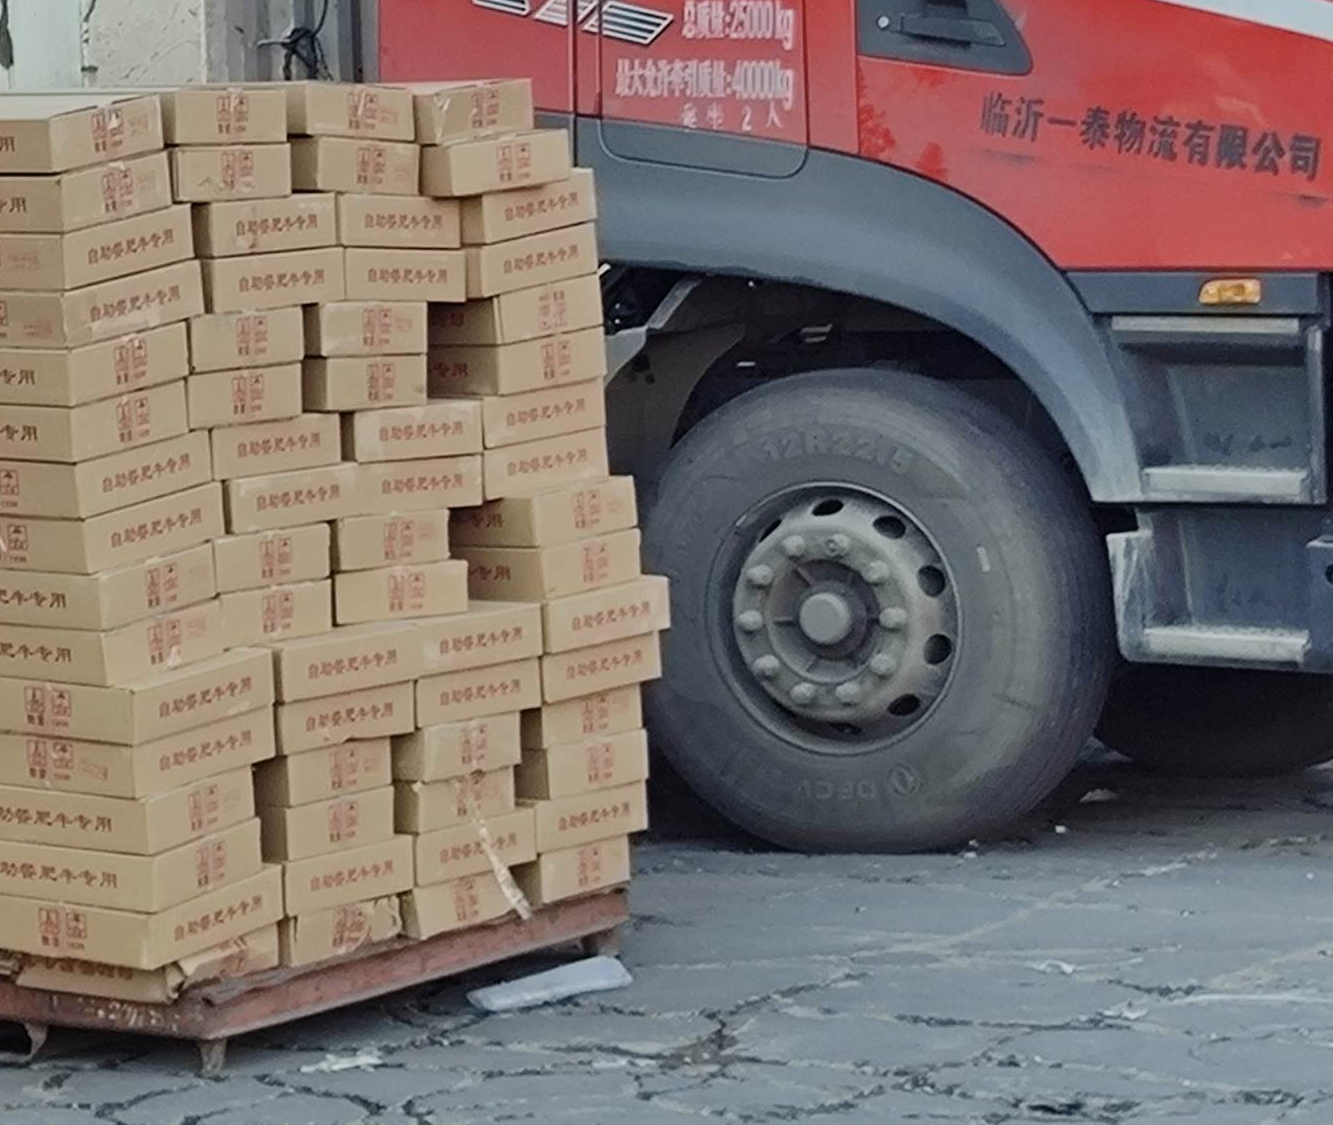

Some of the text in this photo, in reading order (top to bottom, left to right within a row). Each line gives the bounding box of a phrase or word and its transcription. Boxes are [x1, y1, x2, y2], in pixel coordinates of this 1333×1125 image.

[980, 92, 1323, 181] 临沂一泰物流有限公司
